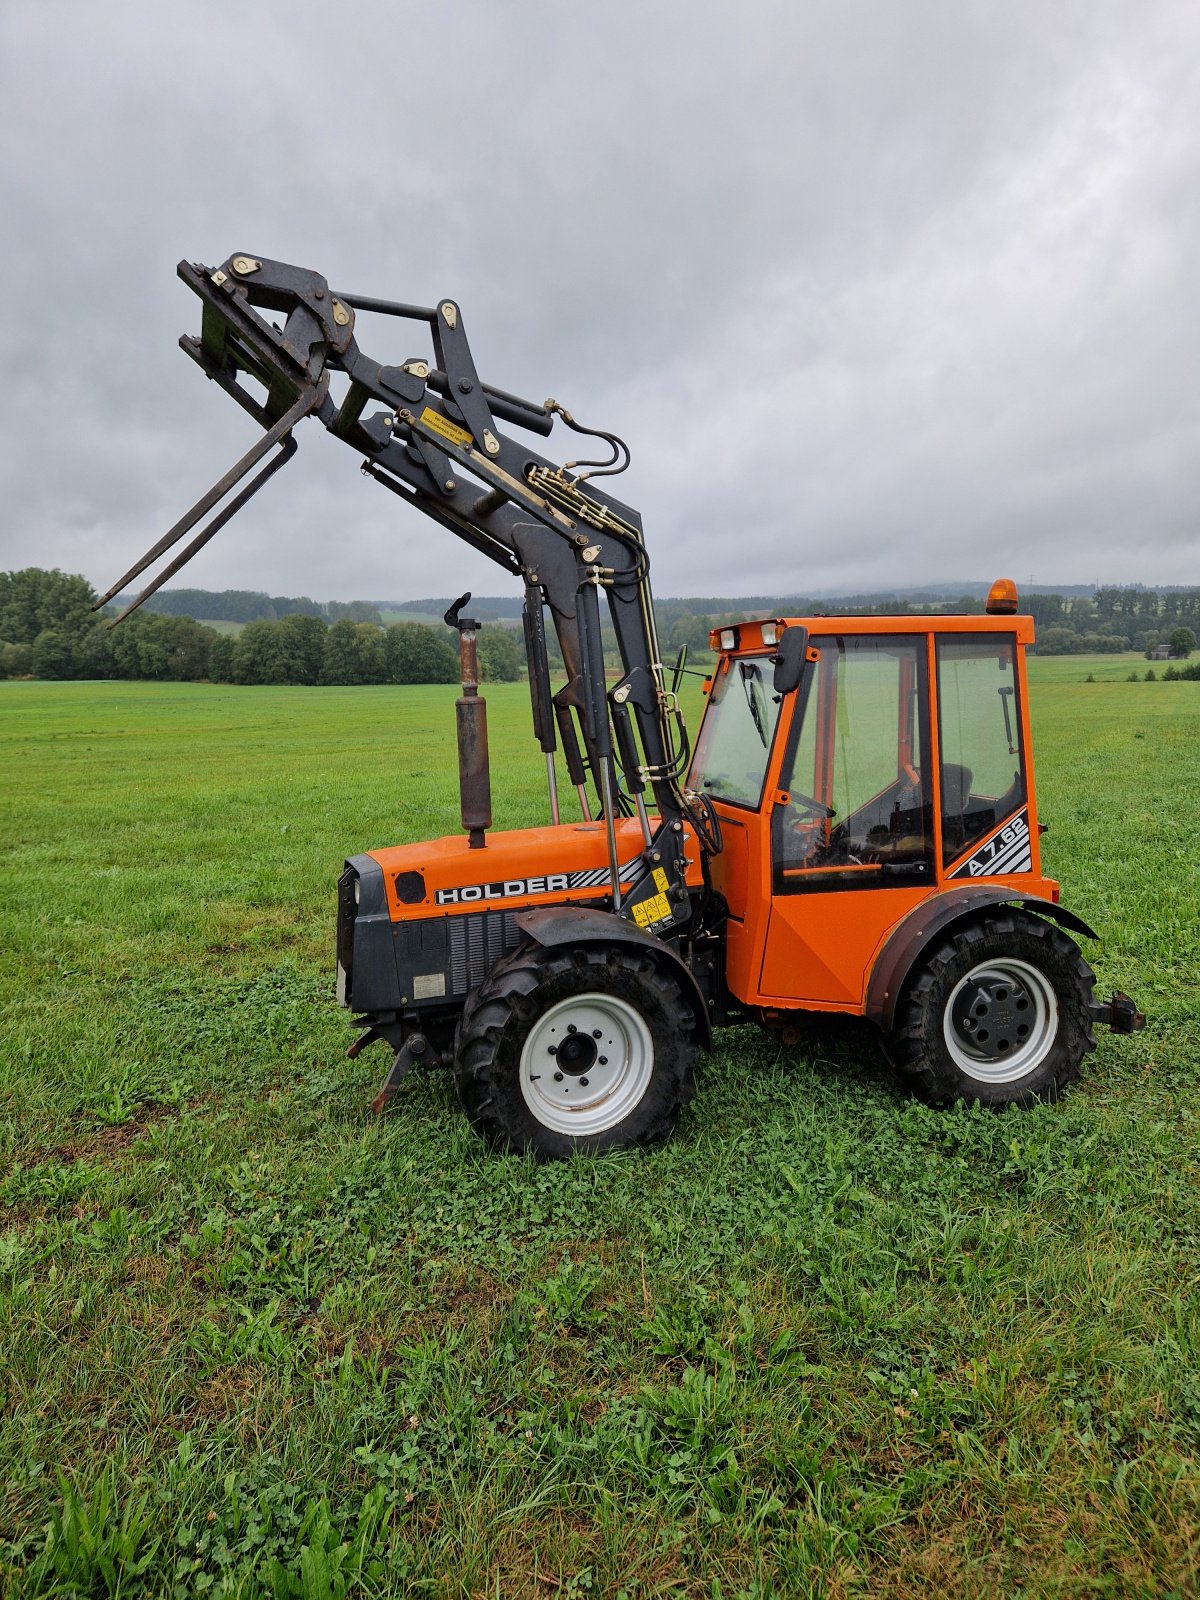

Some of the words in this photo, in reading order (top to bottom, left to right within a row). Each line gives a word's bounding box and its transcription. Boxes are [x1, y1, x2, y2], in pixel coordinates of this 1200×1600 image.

[968, 859, 983, 876] A
[983, 817, 1027, 858] 7.62
[438, 874, 569, 904] HOLDER
